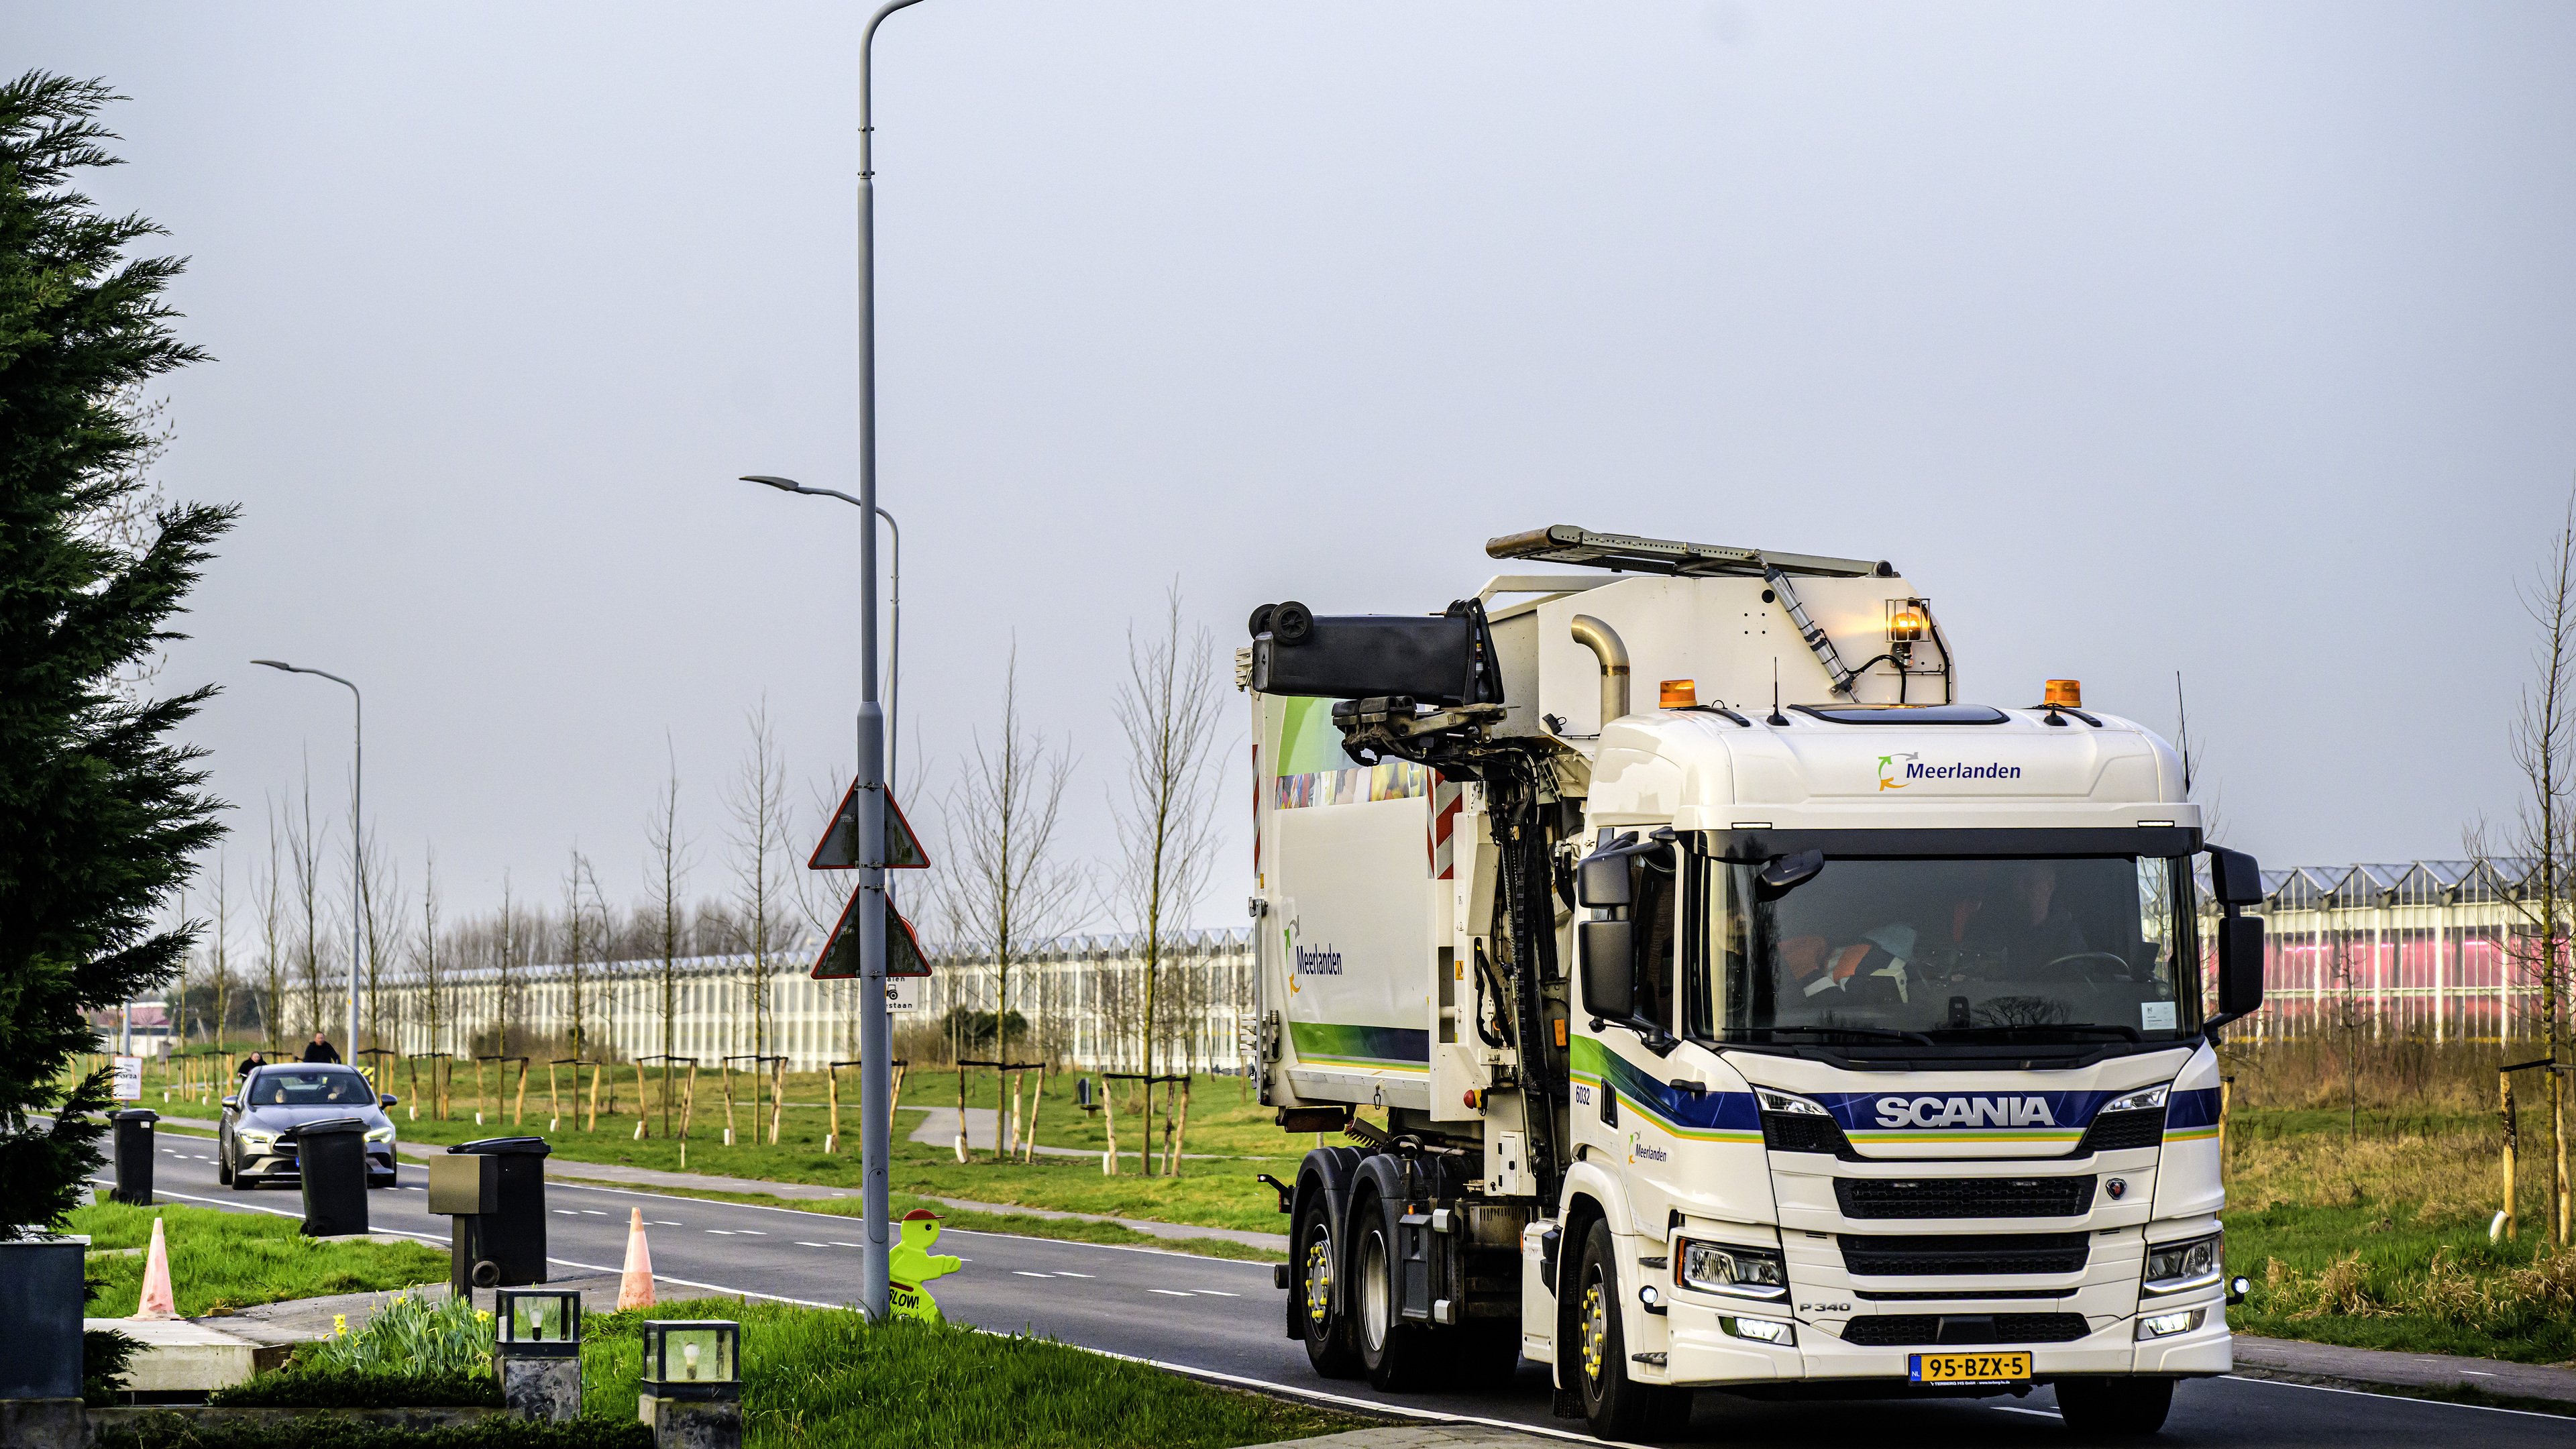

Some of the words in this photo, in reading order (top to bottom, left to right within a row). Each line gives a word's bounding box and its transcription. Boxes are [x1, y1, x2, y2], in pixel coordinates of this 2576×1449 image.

[1907, 762, 2021, 778] Meerlanden
[1296, 943, 1342, 975] Meerlanden
[1576, 1085, 1590, 1106] 6032
[1875, 1097, 2055, 1128] SCANIA
[1635, 1144, 1667, 1162] Meerlanden
[1800, 1302, 1811, 1311] P
[1815, 1302, 1851, 1311] 340
[1930, 1357, 2023, 1377] 95-BZX-5
